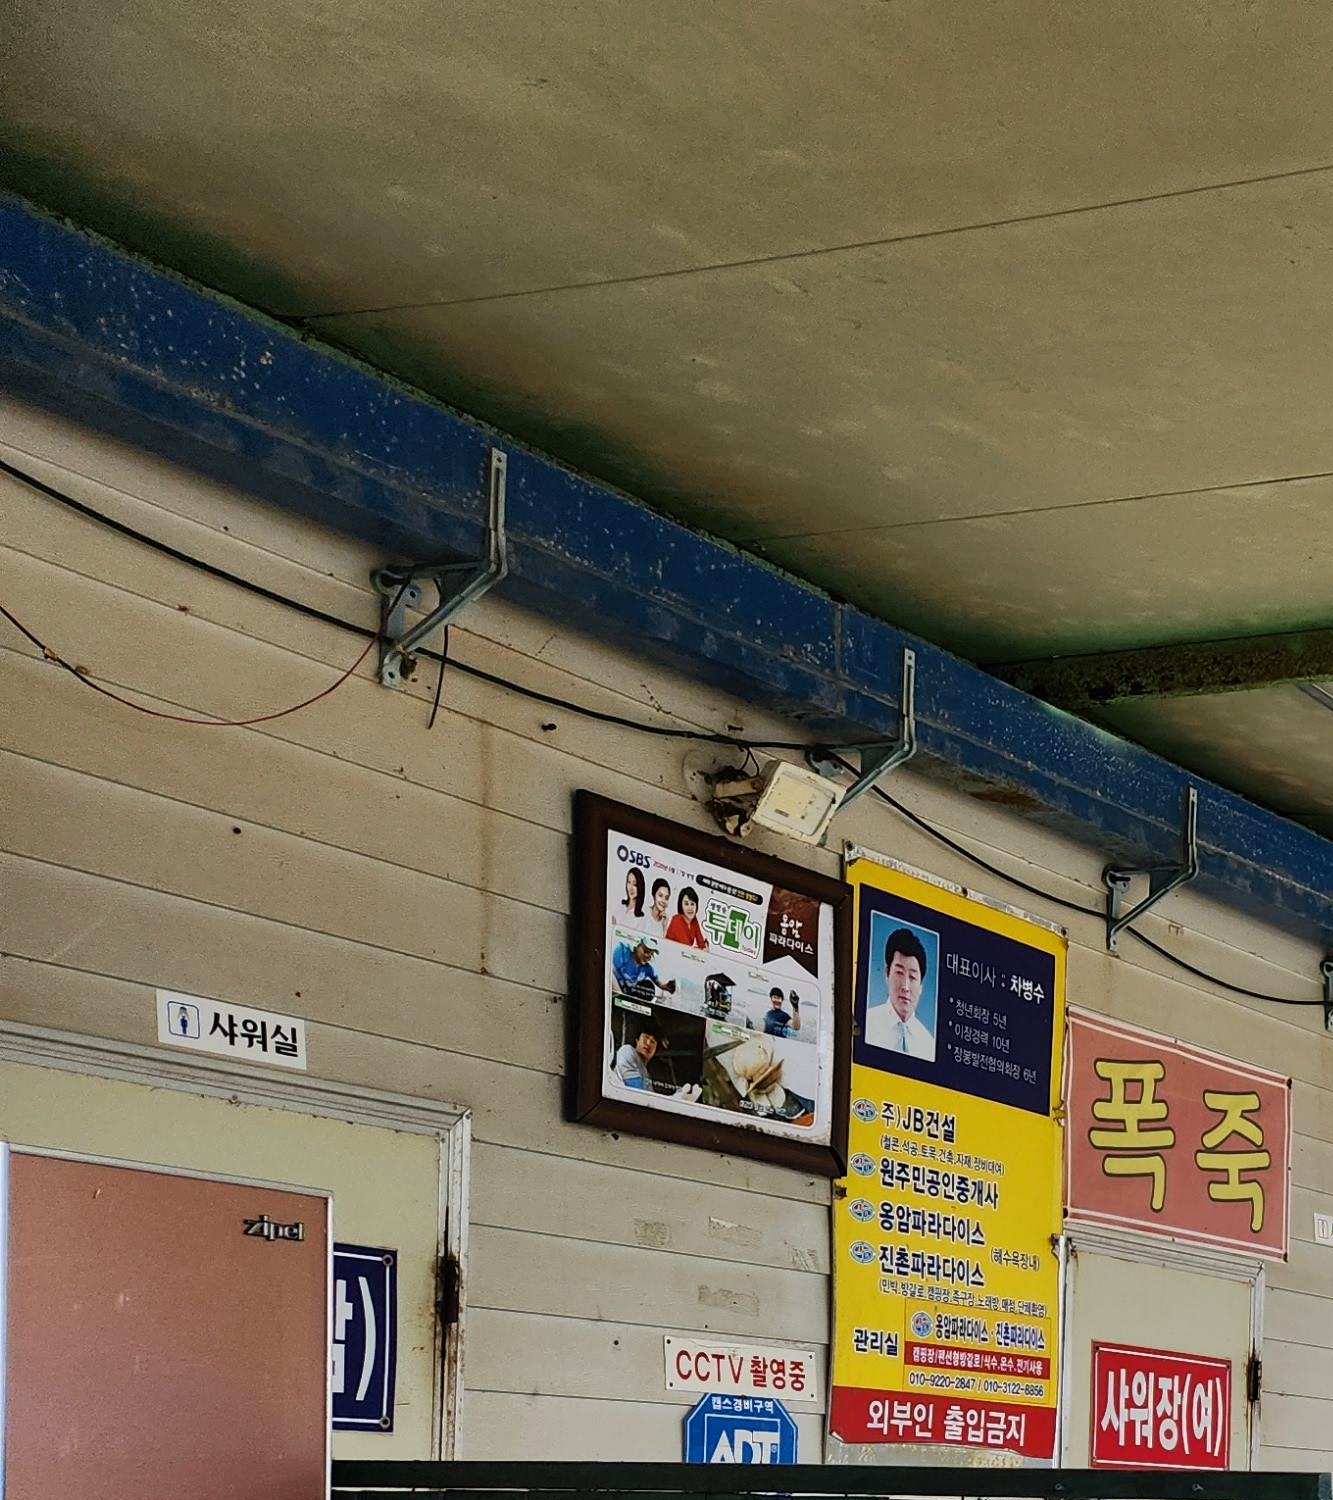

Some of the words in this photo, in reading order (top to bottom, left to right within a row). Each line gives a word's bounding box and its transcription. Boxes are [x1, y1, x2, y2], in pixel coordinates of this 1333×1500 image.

[629, 849, 652, 869] SBS
[705, 910, 759, 949] 투데이
[768, 932, 814, 955] 파라다이스
[780, 914, 803, 938] 옹암
[946, 953, 997, 988] 대표이사
[1010, 974, 1045, 1005] 차병수
[956, 999, 990, 1025] 청년회장
[993, 1012, 1008, 1030] 5년
[209, 1010, 300, 1058] 샤워실
[955, 1023, 989, 1047] 이장경력
[992, 1035, 1010, 1053] 10년
[953, 1045, 1021, 1081] 장봉발전협의회장
[1023, 1067, 1038, 1085] 6년
[879, 1156, 999, 1210] 원주민공인중개사
[243, 1214, 305, 1242] zipel
[879, 1201, 986, 1246] 옹암파라다이스
[879, 1245, 985, 1288] 진촌파라다이스
[990, 1247, 1041, 1272] (해수욕장내)
[853, 1328, 900, 1357] 관리실
[935, 1313, 989, 1343] 옹암파라다이스
[995, 1321, 1046, 1351] 진촌파라다이스
[676, 1349, 744, 1384] CCTV
[750, 1355, 806, 1392] 촬영중
[909, 1372, 977, 1391] 010-9220-2847
[711, 1395, 775, 1415] 캡스경비구역
[867, 1399, 934, 1438] 외부인
[943, 1404, 1026, 1447] 출입금지
[1101, 1368, 1225, 1457] 샤워장(여)
[709, 1428, 780, 1464] ADT
